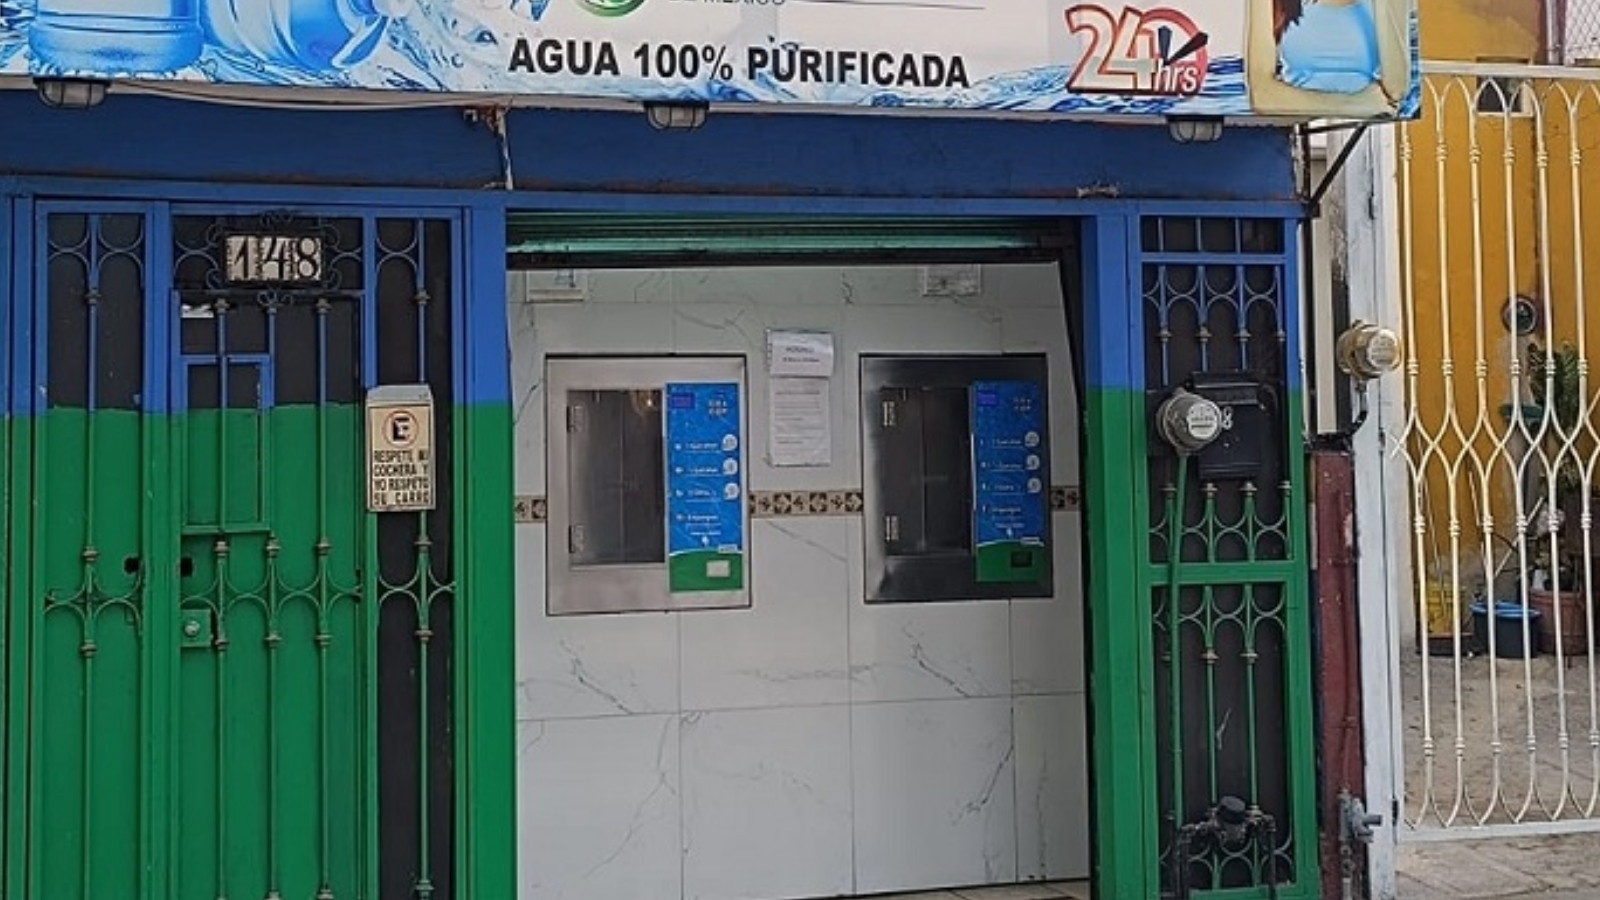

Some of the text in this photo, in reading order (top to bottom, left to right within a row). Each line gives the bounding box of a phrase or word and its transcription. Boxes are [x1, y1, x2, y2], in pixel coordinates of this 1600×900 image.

[1065, 4, 1153, 93] 24
[508, 38, 970, 88] AGUA 100% PURIFICADA
[1154, 60, 1197, 92] hrs
[234, 235, 319, 280] 148
[393, 417, 410, 441] E
[374, 450, 412, 462] RESPETE
[373, 463, 429, 477] COCHERA Y
[373, 477, 430, 491] YO RESPETO
[373, 490, 430, 505] SU CARRO
